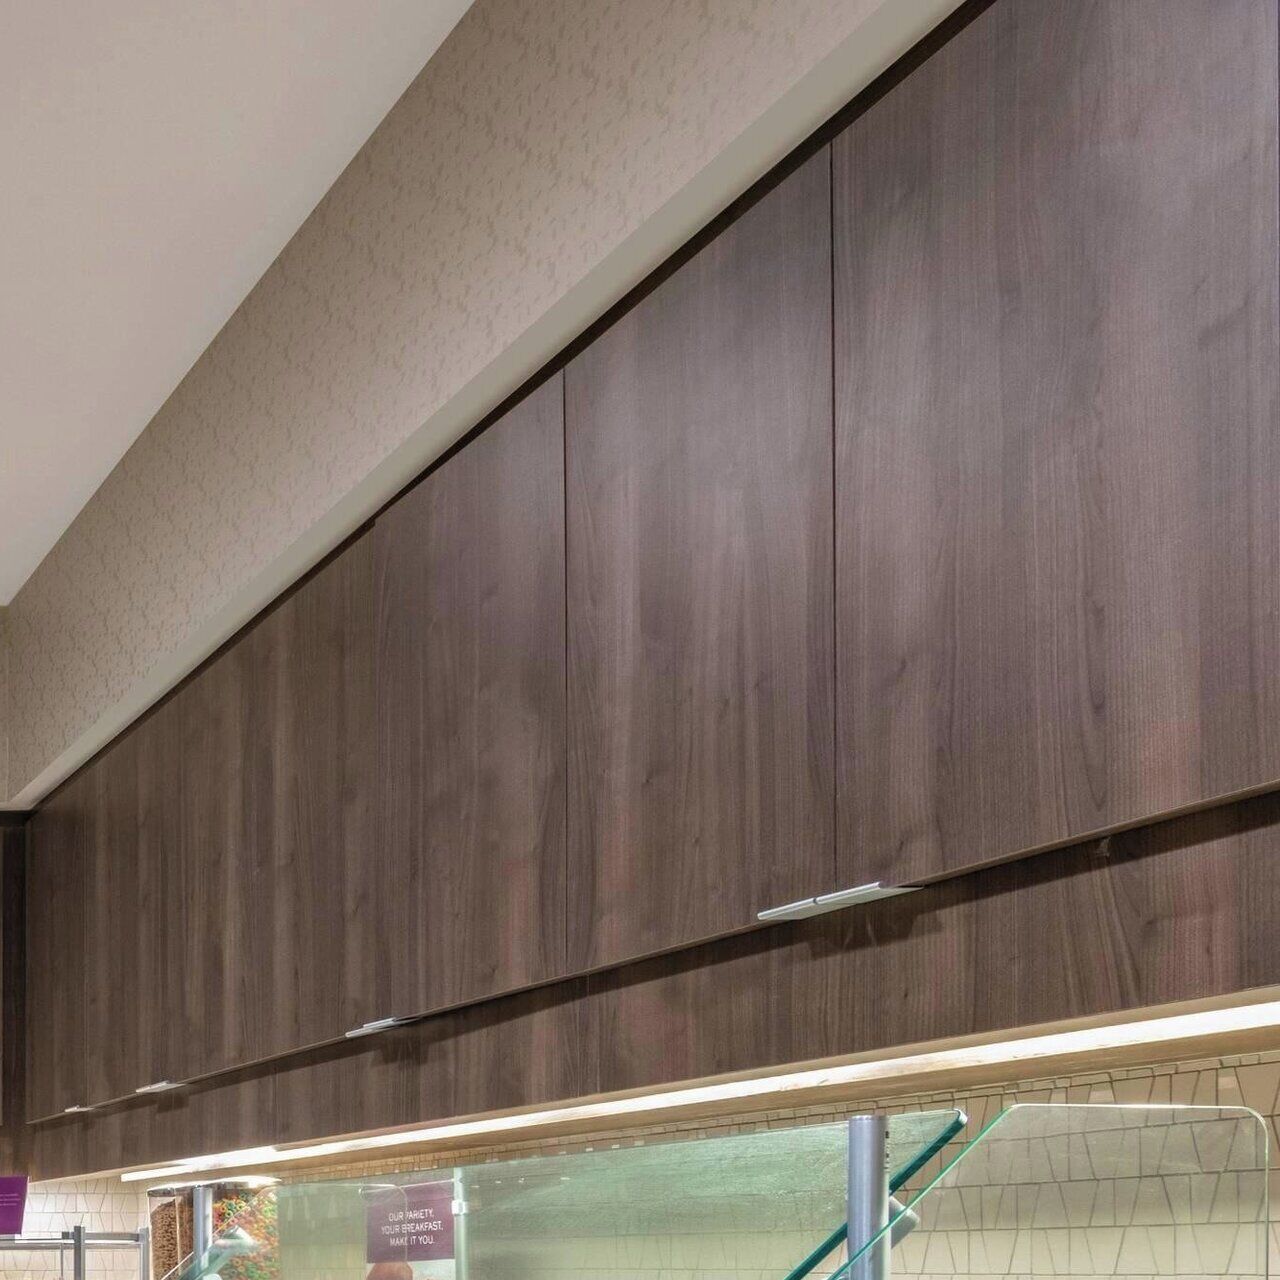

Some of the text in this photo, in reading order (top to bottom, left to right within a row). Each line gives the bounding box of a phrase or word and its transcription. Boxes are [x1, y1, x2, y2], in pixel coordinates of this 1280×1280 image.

[388, 1211, 404, 1221] OUR
[381, 1224, 400, 1235] YOUR
[410, 1236, 417, 1245] IT
